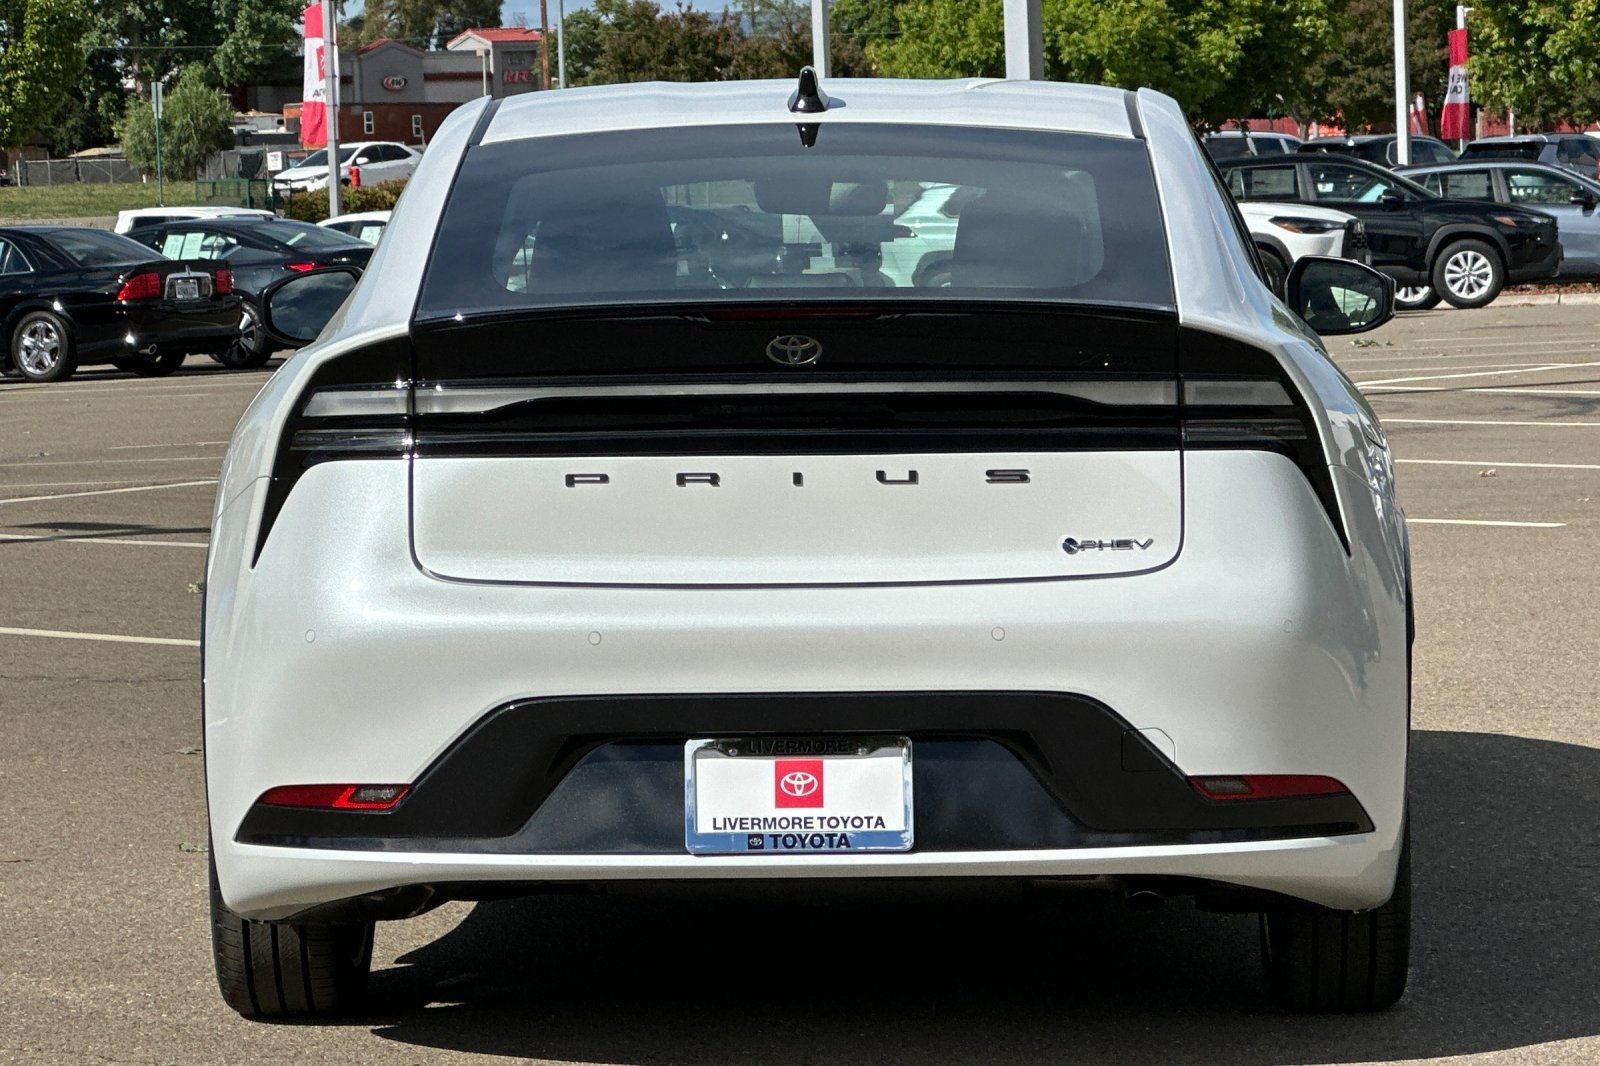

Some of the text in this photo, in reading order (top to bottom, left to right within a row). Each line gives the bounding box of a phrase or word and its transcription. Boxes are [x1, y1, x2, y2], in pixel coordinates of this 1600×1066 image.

[565, 469, 1030, 488] PRIUS
[1080, 537, 1154, 551] PHEV
[748, 740, 849, 755] LIVERMORE
[712, 815, 886, 830] LIVERMORE TOYOTA
[769, 833, 851, 849] TOYOTA
